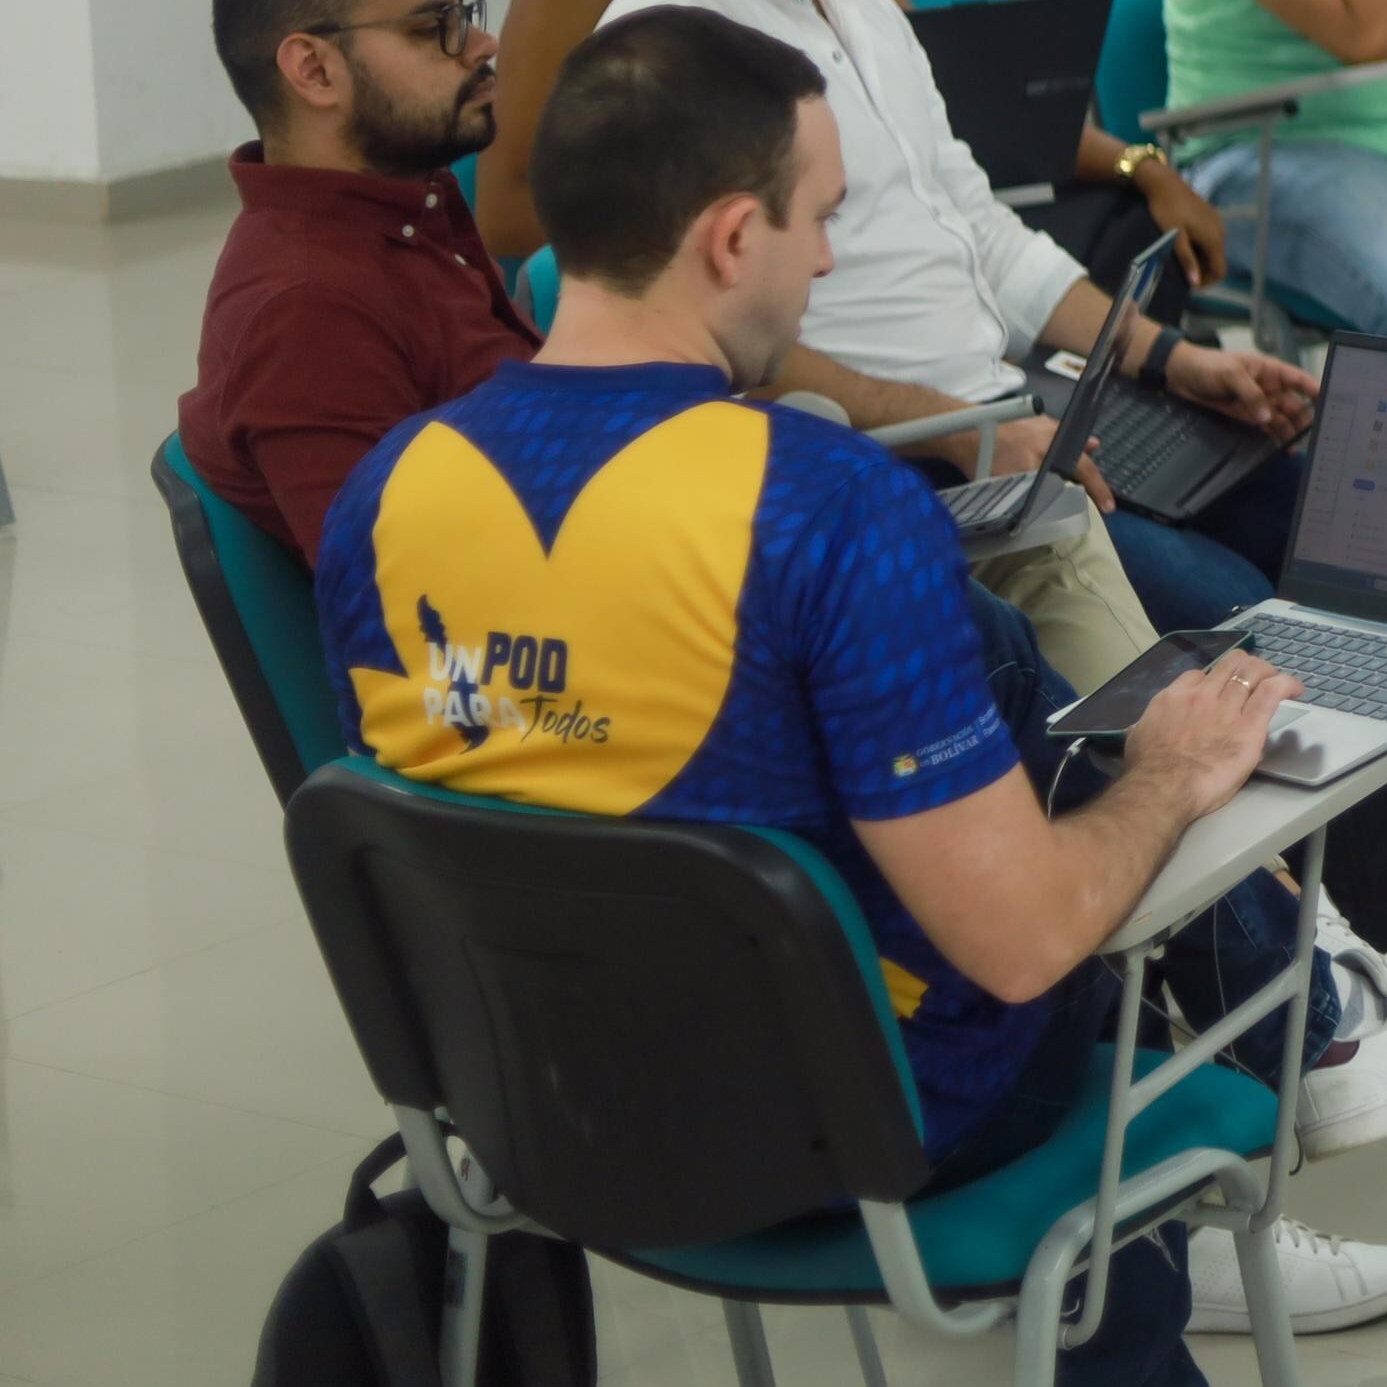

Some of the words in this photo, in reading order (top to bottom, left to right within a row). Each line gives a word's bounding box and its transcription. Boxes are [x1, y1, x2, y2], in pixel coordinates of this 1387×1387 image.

[429, 642, 481, 682] UN
[483, 632, 568, 693] POD
[424, 688, 527, 732] PARA
[520, 694, 611, 744] Todos
